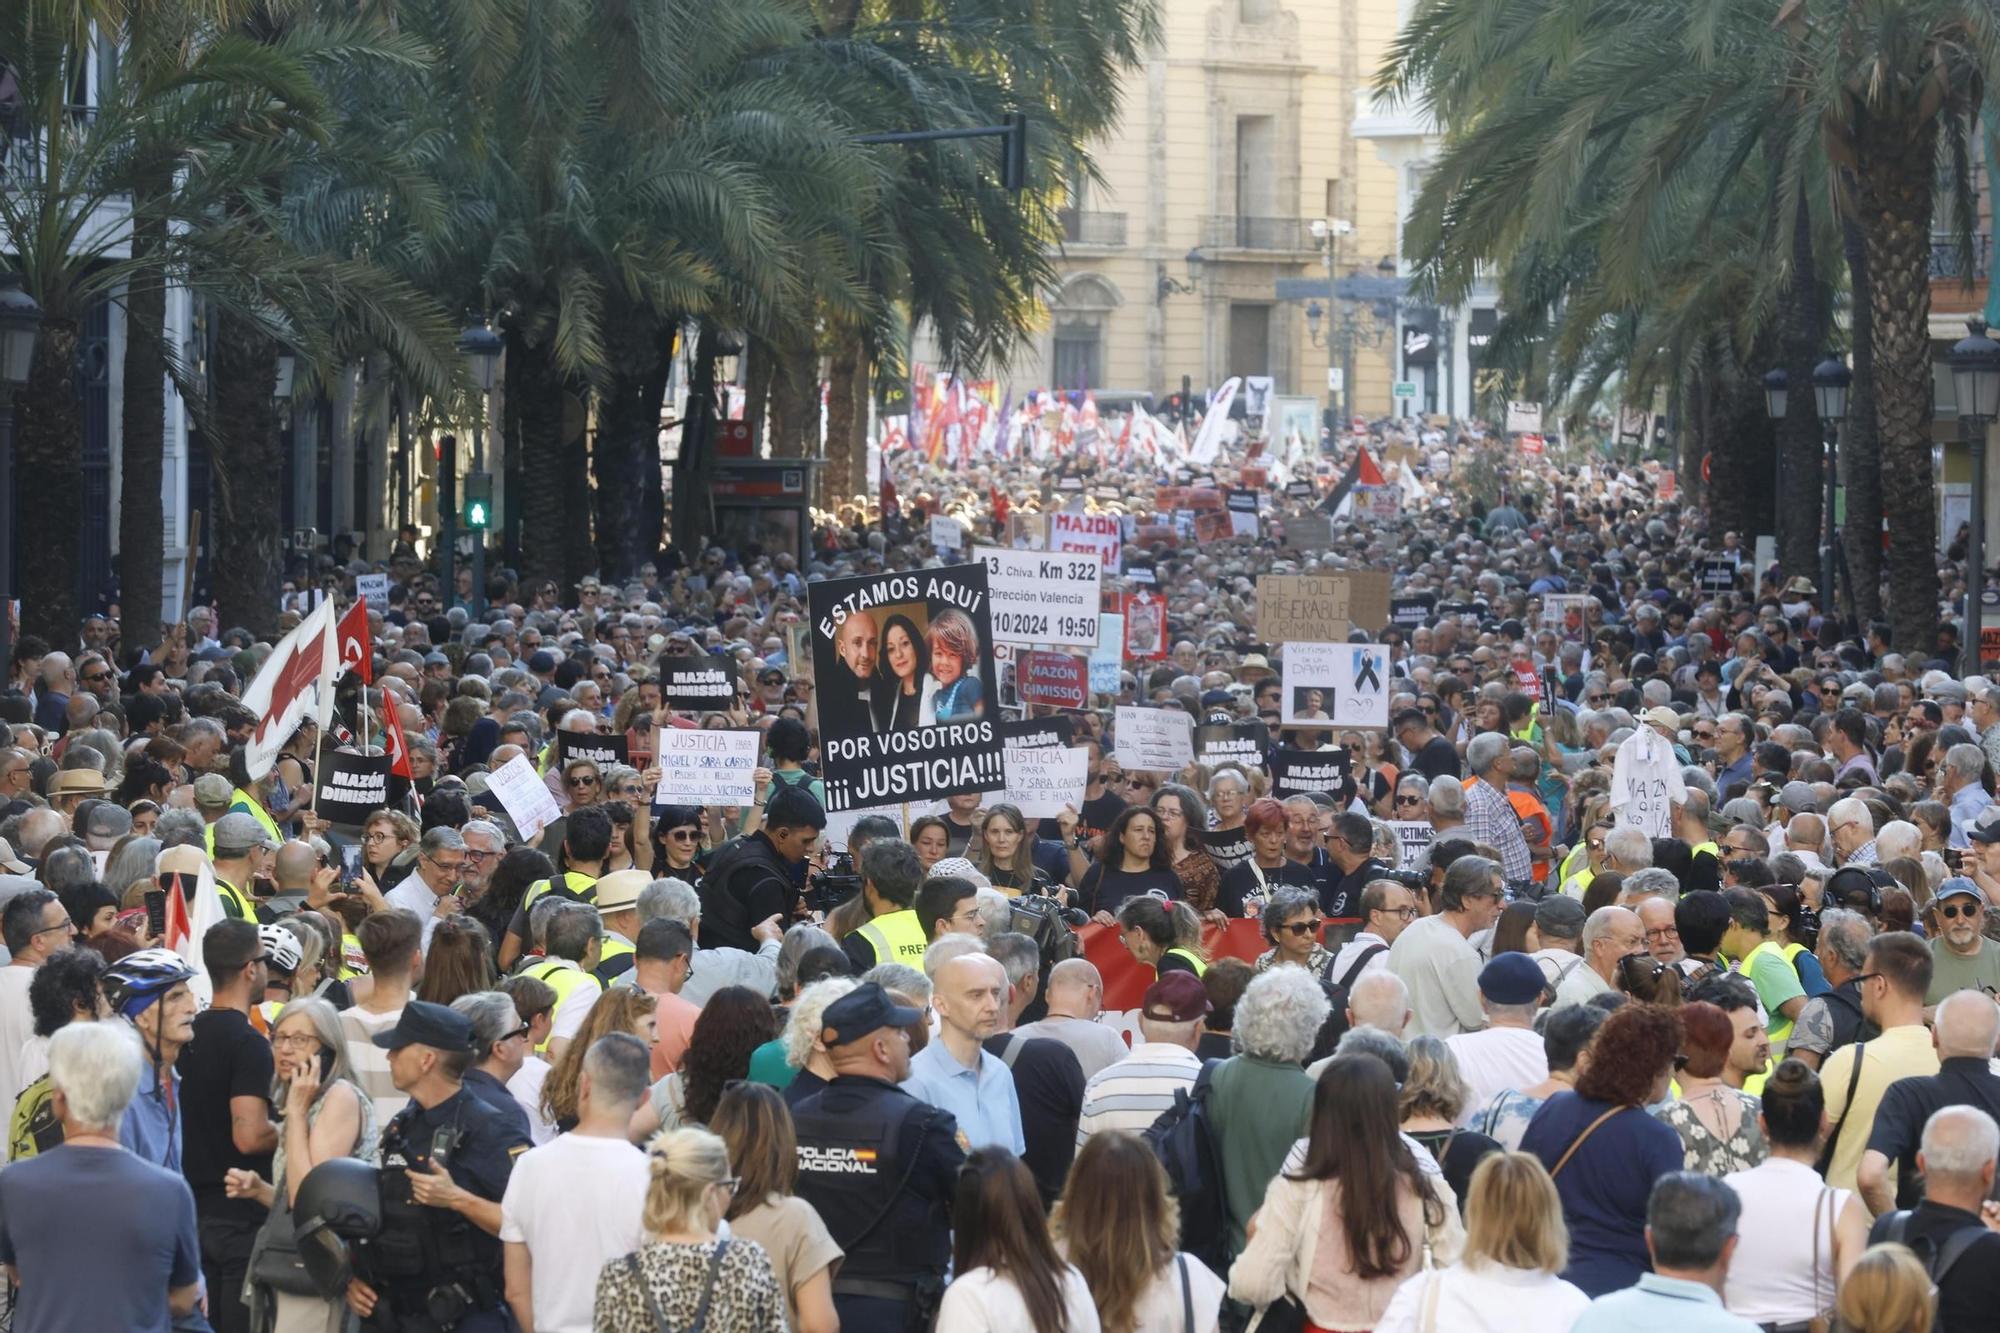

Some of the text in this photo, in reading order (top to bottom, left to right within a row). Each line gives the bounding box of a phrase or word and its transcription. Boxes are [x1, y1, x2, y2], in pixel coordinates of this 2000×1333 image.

[1006, 565, 1036, 578] Chiva.
[1040, 560, 1063, 580] Km
[1067, 562, 1096, 581] 322
[1040, 591, 1084, 605] Valencia
[819, 576, 983, 640] ESTAMOS AQUÍ
[1263, 599, 1349, 620] MISERABLE
[1057, 615, 1096, 638] 19:50
[1268, 620, 1339, 641] CRIMINAL
[673, 668, 726, 684] MAZÓN
[1028, 664, 1078, 681] MAZÓN
[666, 681, 734, 697] DIMISSIÓ
[1023, 682, 1083, 701] DIMISSIÓ
[671, 734, 727, 750] JUSTICIA
[827, 721, 993, 762] POR VOSOTROS
[1004, 731, 1059, 748] MAZÓN
[1205, 737, 1257, 752] MAZÓN
[568, 746, 616, 761] MAZÓN
[332, 770, 385, 788] MAZÓN
[855, 751, 1002, 800] JUSTICIA!!!
[1021, 766, 1047, 775] PARA
[1288, 763, 1340, 779] MAZÓN
[1279, 775, 1343, 791] DIMISSIÓ
[321, 785, 387, 804] DIMISSIÓ
[1003, 789, 1033, 801] PADRE
[796, 1146, 858, 1160] POLICIA
